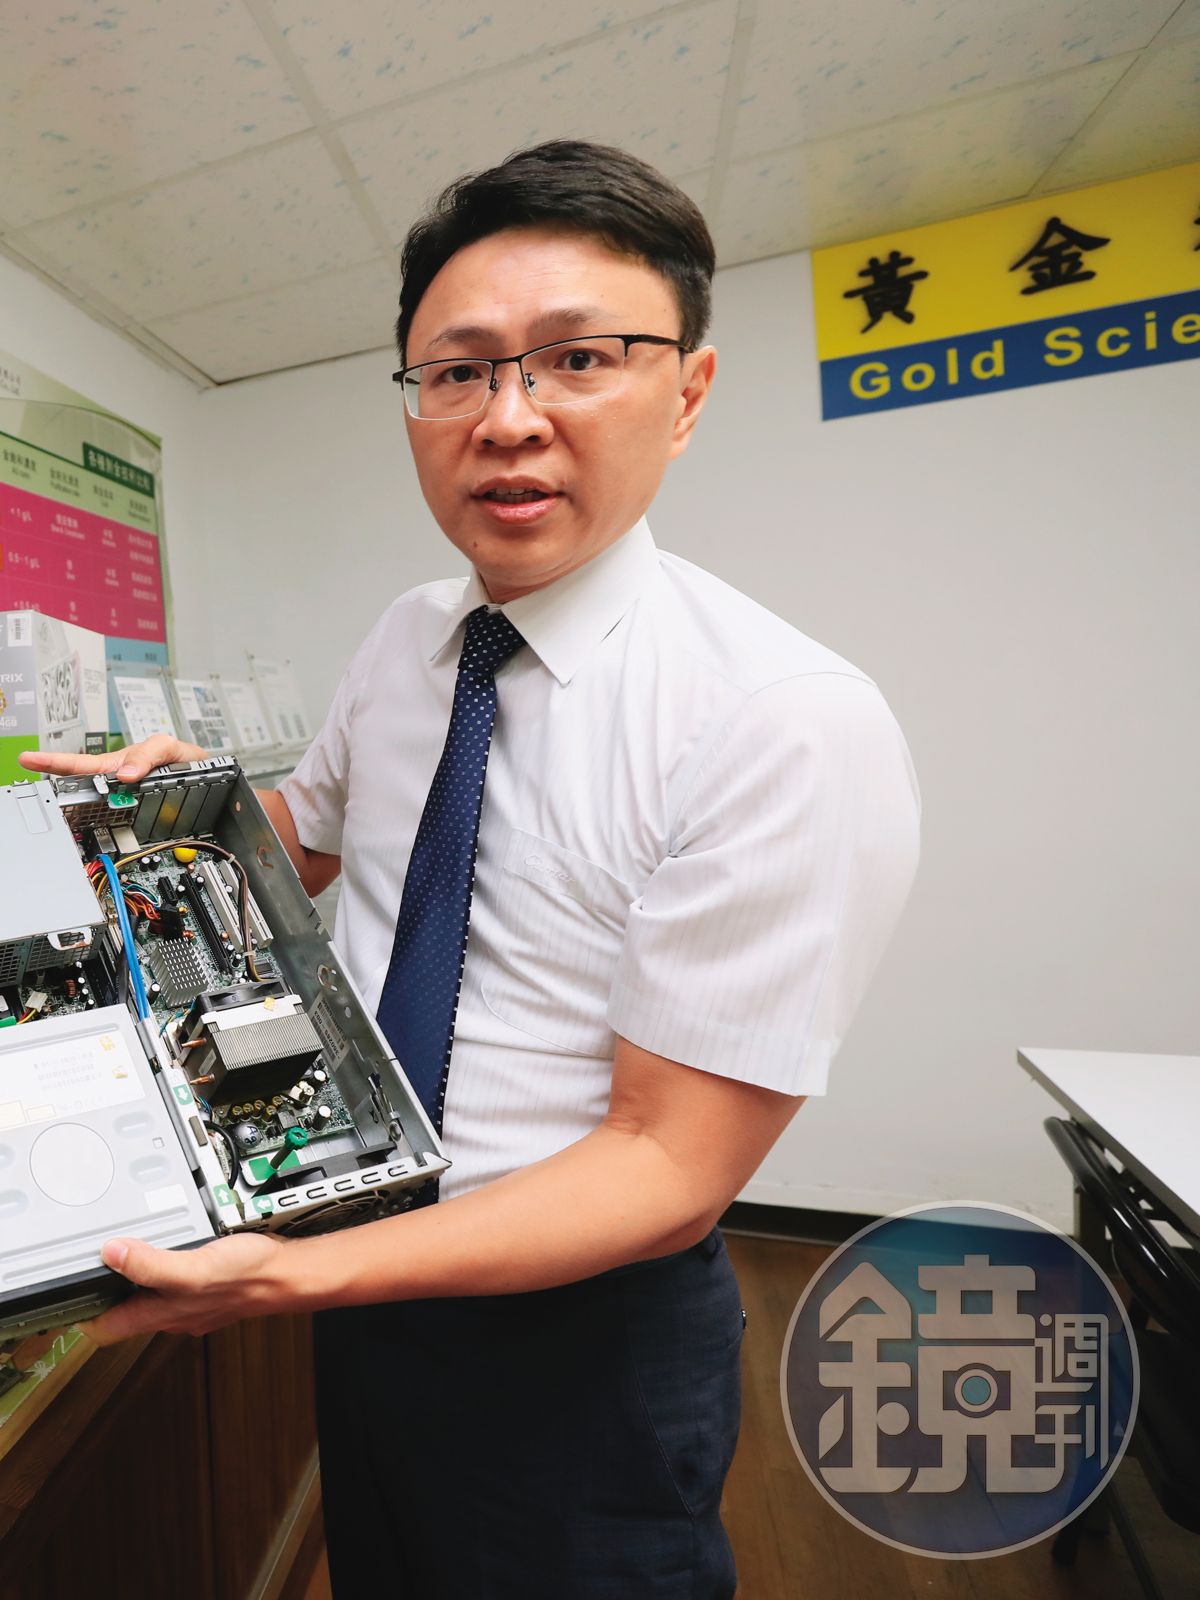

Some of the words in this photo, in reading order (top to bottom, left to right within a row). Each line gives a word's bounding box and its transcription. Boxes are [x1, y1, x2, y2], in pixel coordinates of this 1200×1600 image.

[843, 200, 1200, 334] 黃金
[850, 339, 1005, 399] Gold
[1044, 311, 1200, 366] Scie
